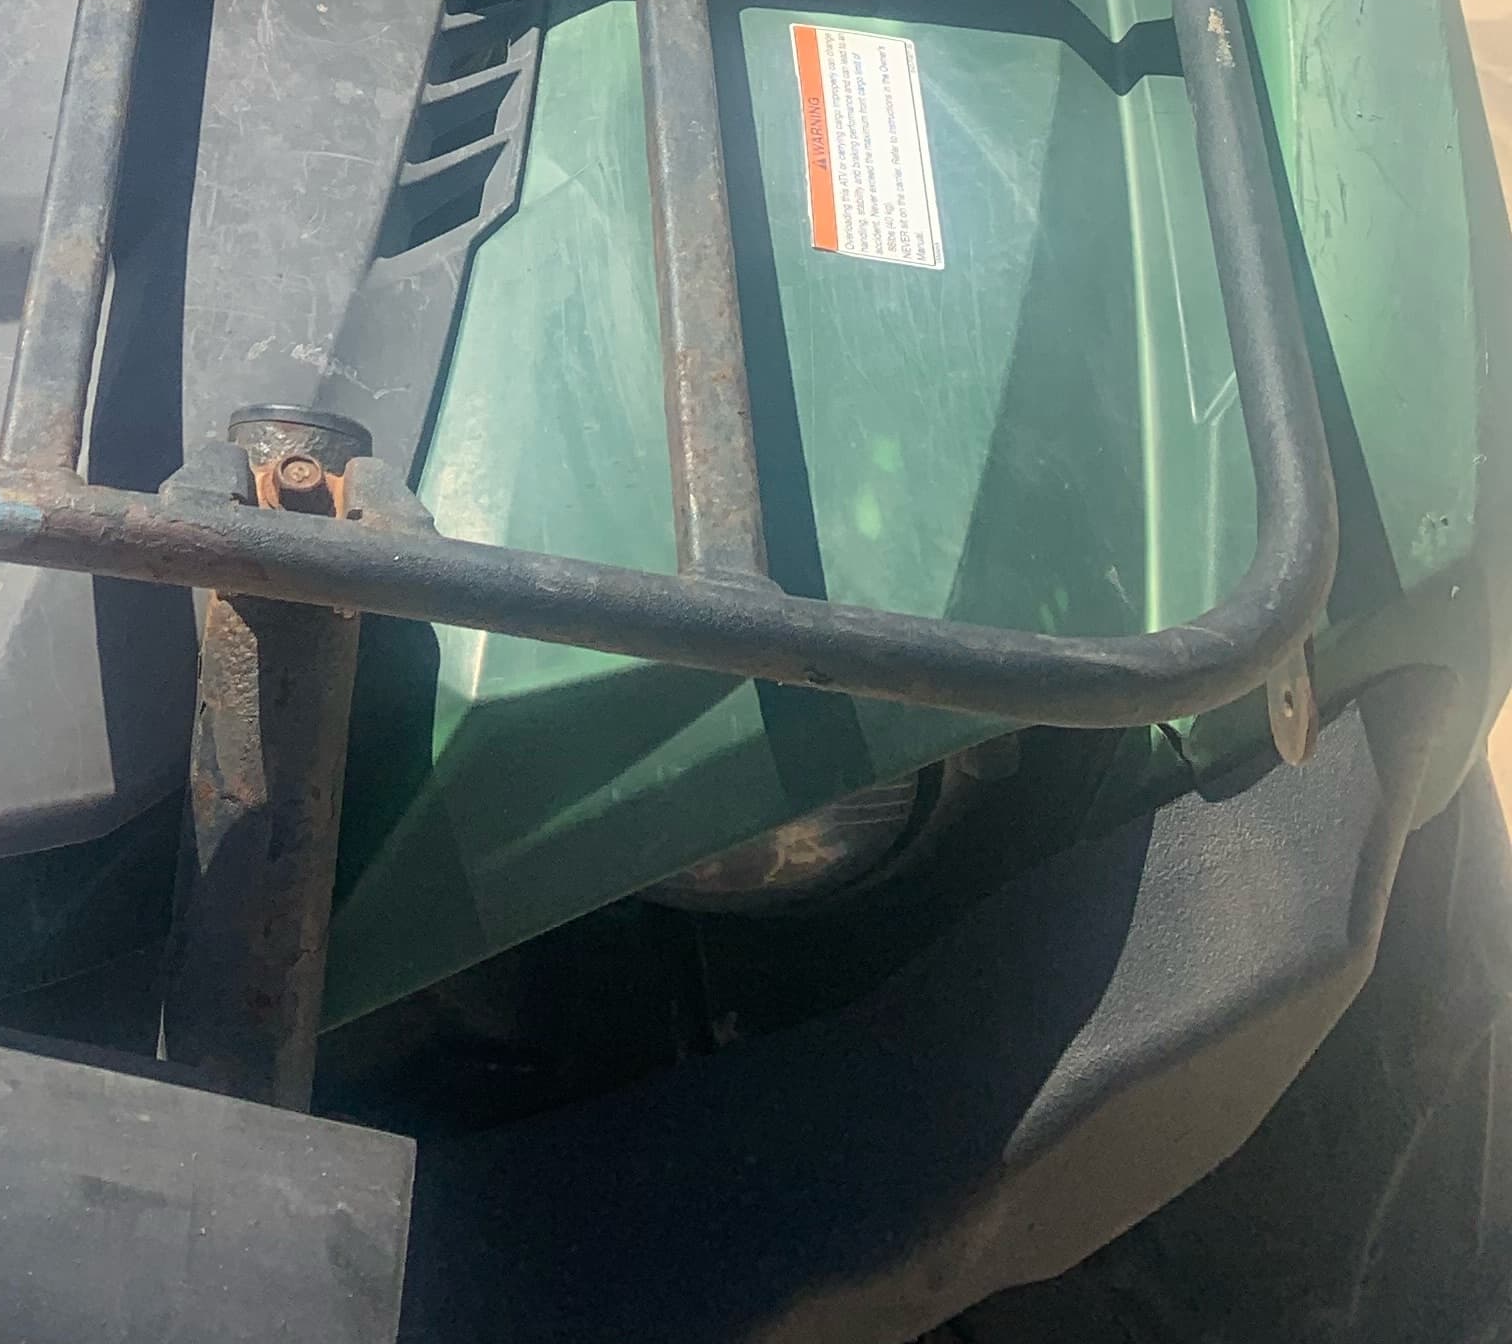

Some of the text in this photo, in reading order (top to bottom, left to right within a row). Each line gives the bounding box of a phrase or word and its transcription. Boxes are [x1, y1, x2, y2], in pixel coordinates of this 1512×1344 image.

[823, 32, 835, 57] change
[828, 57, 836, 70] can
[838, 50, 847, 63] lead
[852, 60, 862, 75] limit
[877, 45, 888, 72] Owner's
[841, 65, 849, 78] can
[827, 71, 841, 108] improperly
[841, 79, 851, 93] and
[856, 76, 867, 96] cargo
[834, 109, 843, 129] cargo
[843, 93, 858, 139] performance
[883, 93, 896, 134] instructions
[807, 96, 825, 155] WARNING
[859, 115, 871, 150] maximum
[834, 130, 847, 160] carrying
[848, 140, 861, 168] braking
[889, 145, 900, 164] Refer
[863, 151, 873, 164] the
[838, 171, 848, 186] ATV
[852, 169, 861, 184] and
[865, 164, 876, 193] exceed
[839, 187, 850, 202] this
[854, 185, 866, 216] stability
[868, 194, 879, 217] Never
[895, 192, 905, 205] the
[841, 202, 857, 250] Overloading
[899, 230, 912, 259] NEVER
